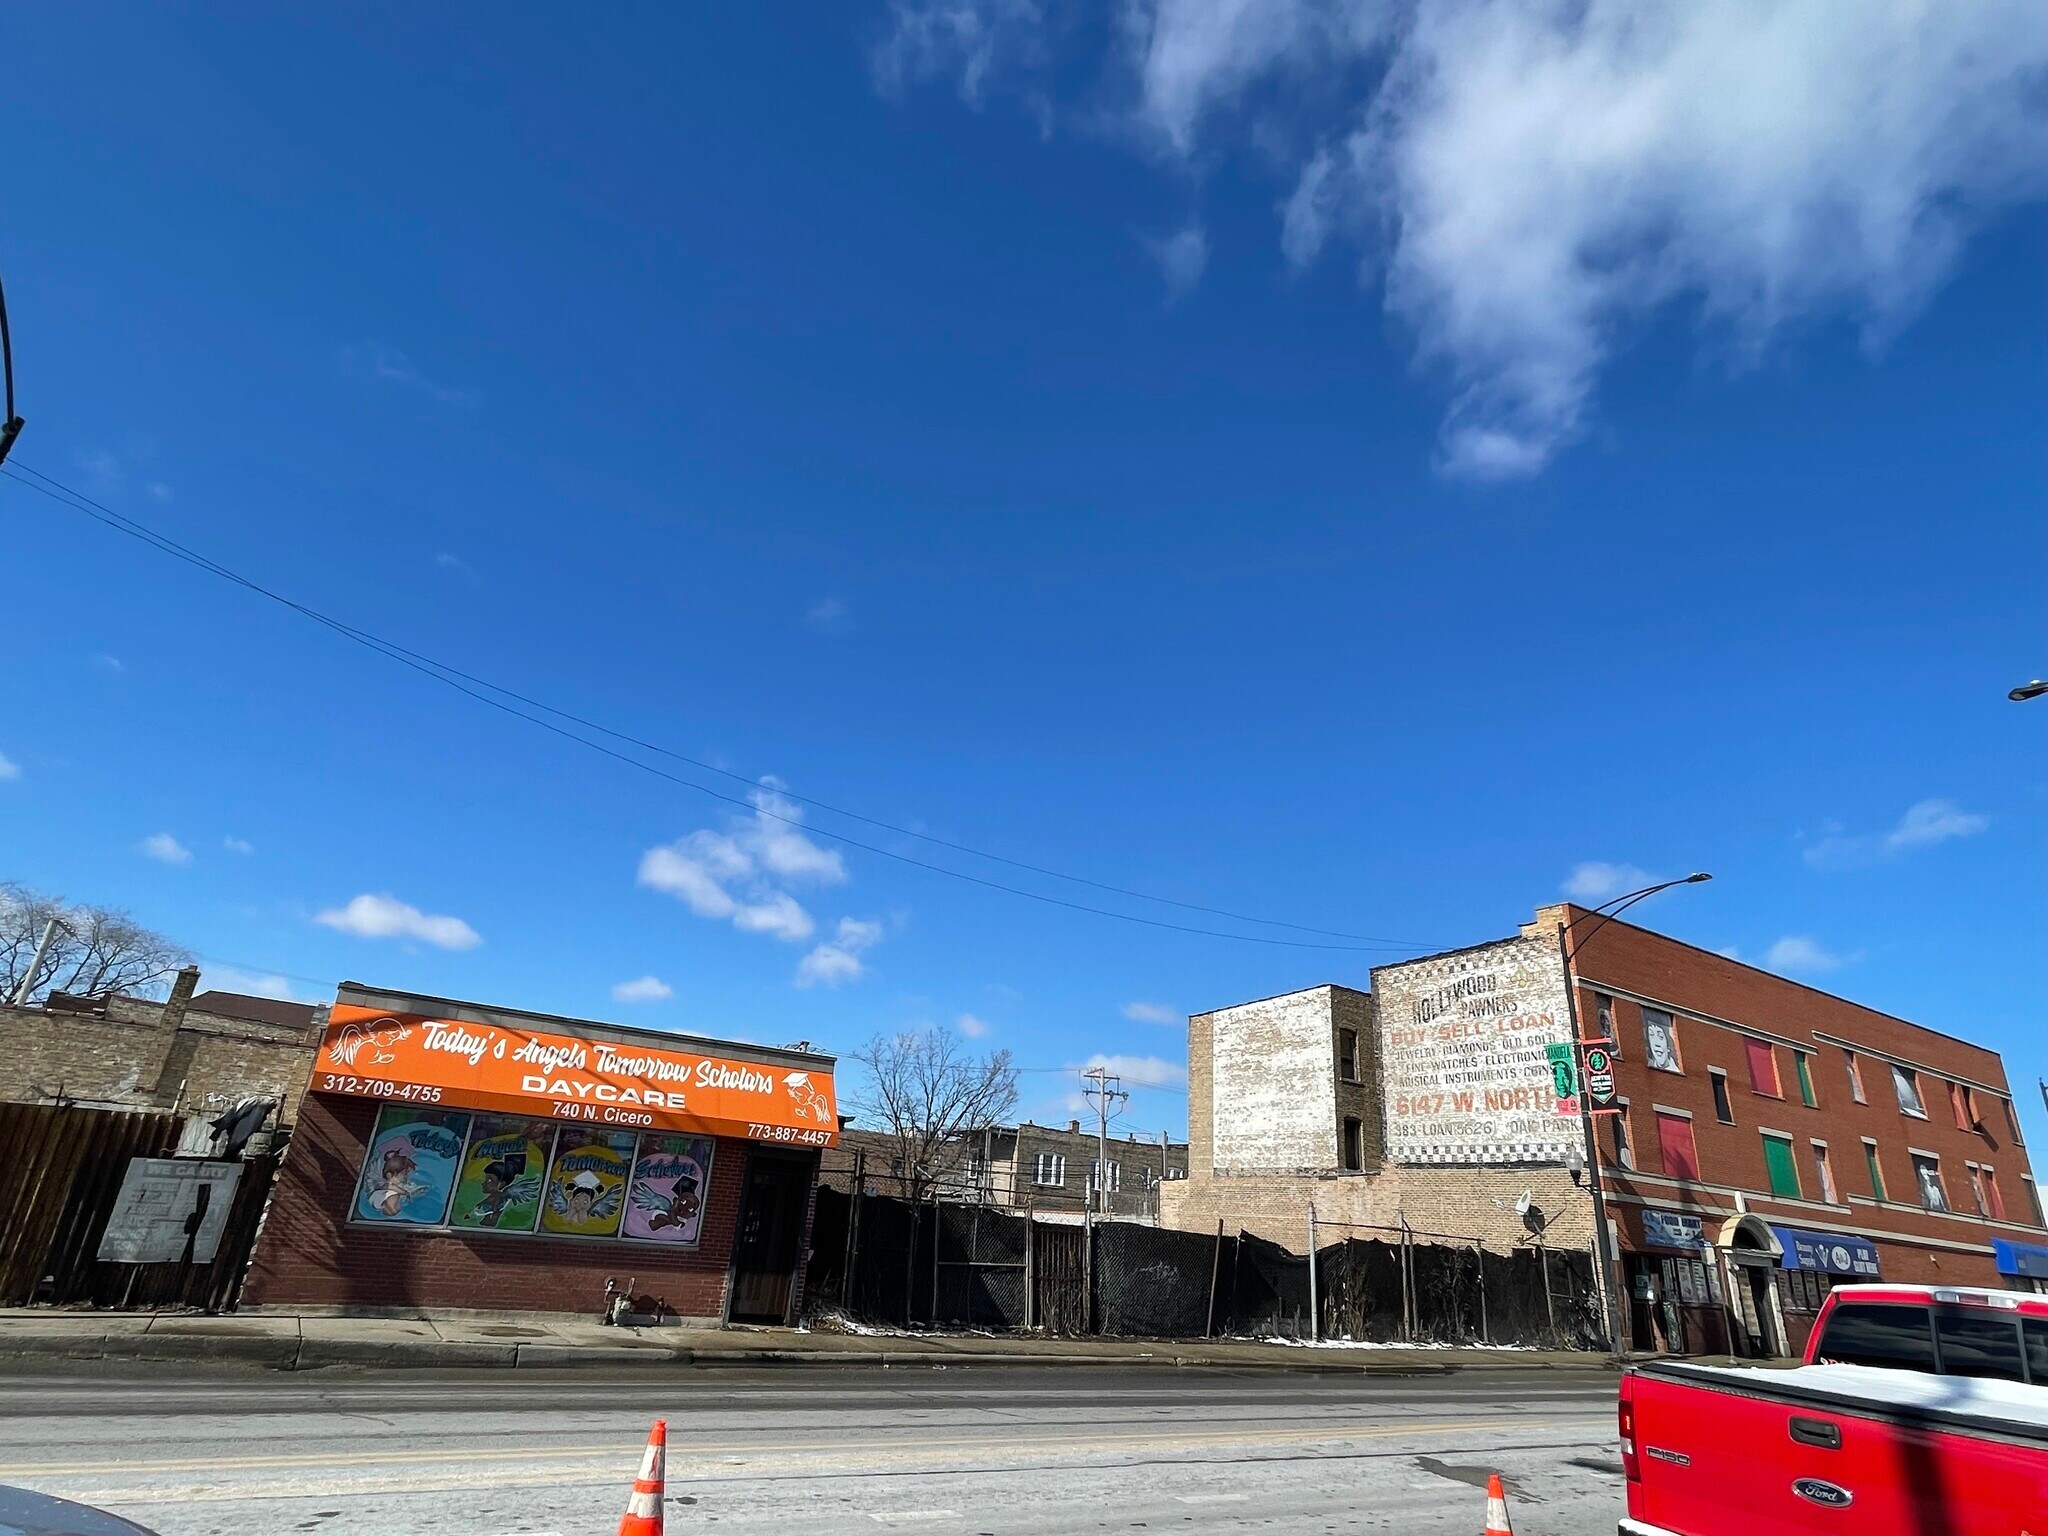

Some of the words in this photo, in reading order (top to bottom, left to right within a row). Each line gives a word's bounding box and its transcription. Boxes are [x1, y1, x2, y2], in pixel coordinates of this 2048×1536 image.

[1412, 973, 1497, 1024] HOLLYWOOD
[1461, 995, 1518, 1019] PAWNERS
[1439, 1022, 1482, 1041] SELL
[1498, 1013, 1555, 1033] LOAN
[422, 1020, 506, 1066] Today's
[512, 1037, 586, 1074] Angels
[593, 1044, 691, 1083] Tomorrow
[695, 1060, 773, 1095] Scholars
[1395, 1047, 1437, 1061] JEWELRY
[1442, 1040, 1496, 1056] DIAMONDS
[1503, 1037, 1522, 1051] OLD
[1527, 1033, 1555, 1047] GOLD
[1431, 1057, 1477, 1072] WATCHES
[1486, 1049, 1548, 1066] ELECTRONIC
[1445, 1066, 1516, 1086] INSTRUMENTS
[323, 1074, 442, 1103] 312-709-4755
[521, 1075, 686, 1110] DAYCARE
[552, 1101, 580, 1118] 740
[584, 1105, 599, 1120] N.
[604, 1107, 653, 1126] Cicero
[1543, 1116, 1580, 1133] PARK
[748, 1123, 832, 1146] 773-887-4457
[147, 1164, 172, 1175] WE
[175, 1165, 228, 1178] CARRY
[1805, 1482, 1838, 1502] Ford
